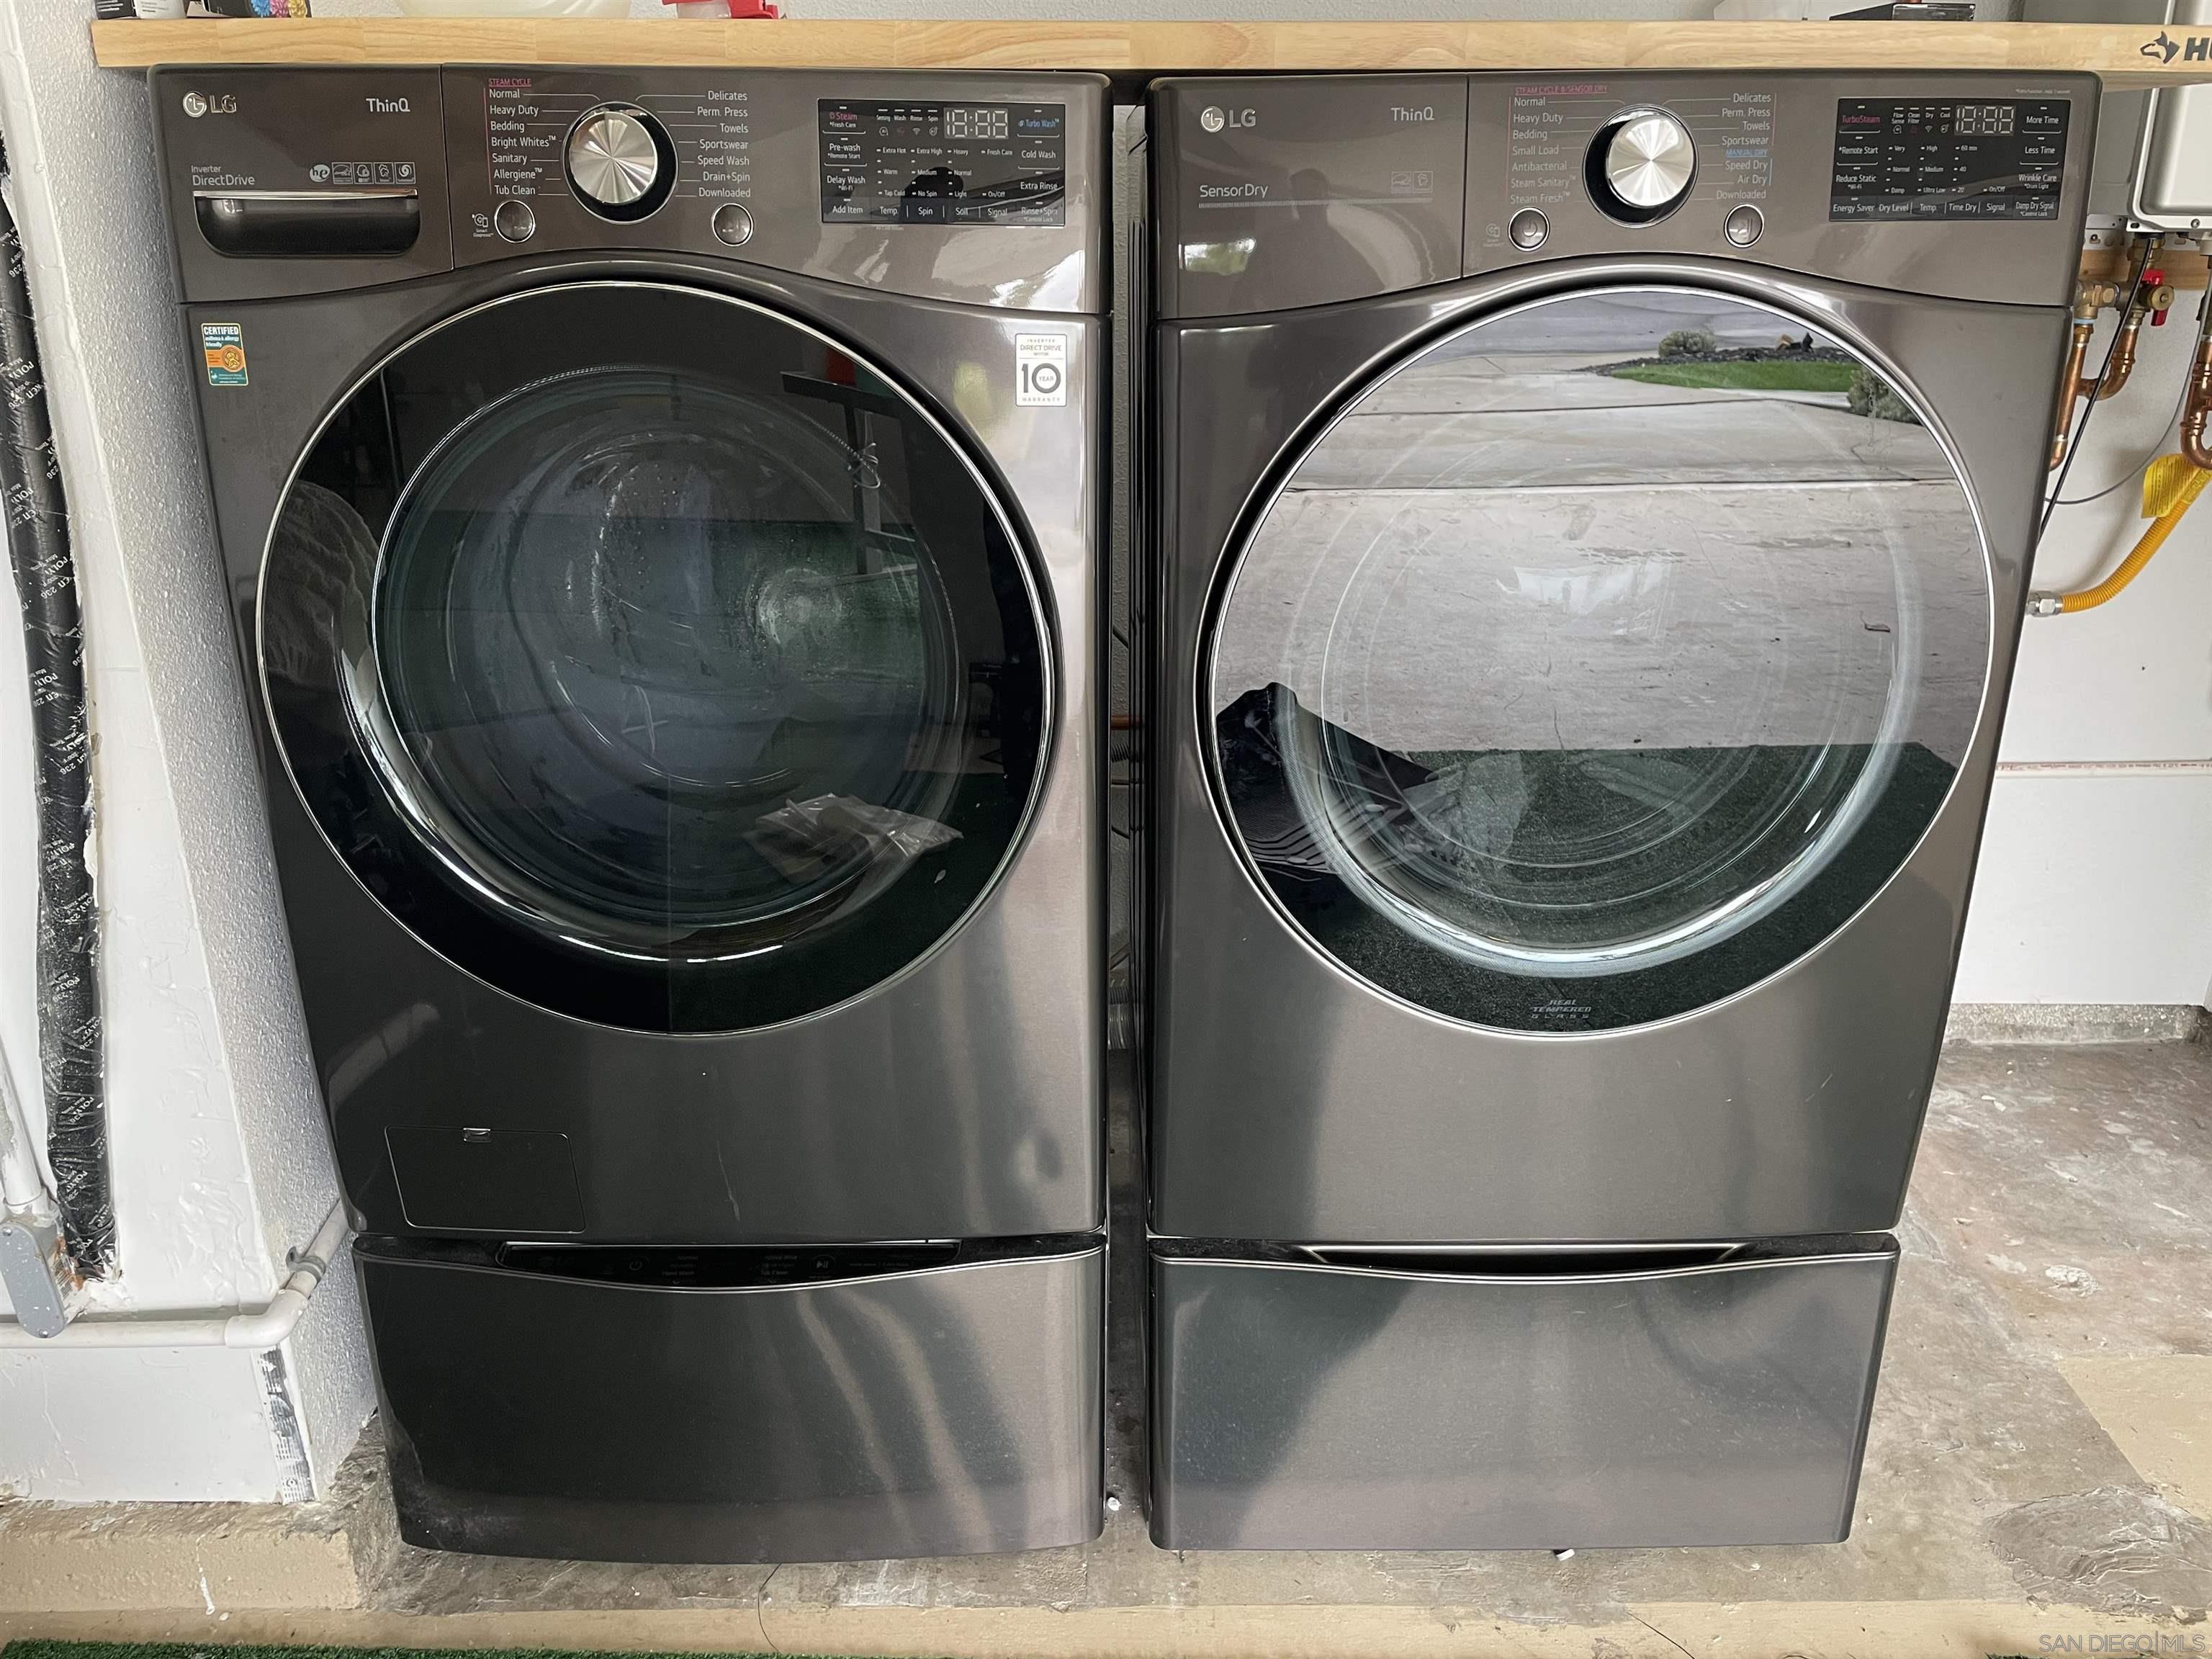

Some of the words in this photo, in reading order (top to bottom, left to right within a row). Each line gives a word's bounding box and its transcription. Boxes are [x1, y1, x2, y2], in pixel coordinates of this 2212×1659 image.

[489, 88, 520, 98] Normal
[708, 91, 747, 101] Delicates
[1733, 93, 1771, 103] Delicates
[366, 98, 410, 113] ThinQ
[1514, 96, 1545, 107] Normal
[490, 105, 516, 117] Heavy
[518, 105, 539, 117] Duty
[724, 107, 748, 117] Press
[1391, 107, 1435, 122] ThinQ
[1722, 108, 1745, 117] Perm.
[1748, 107, 1771, 117] Press
[1514, 114, 1539, 125] Heavy
[1542, 112, 1564, 124] Duty
[2044, 115, 2059, 124] Time
[490, 121, 525, 133] Bedding
[720, 122, 749, 133] Towels
[1743, 121, 1771, 131] Towels
[1512, 129, 1548, 141] Bedding
[491, 137, 517, 149] Bright
[699, 138, 749, 151] Sportswear
[1722, 135, 1769, 148] Sportswear
[830, 143, 861, 151] Pre-wash
[1512, 145, 1536, 156] Small
[1538, 145, 1560, 156] Load
[2041, 145, 2056, 154] Time
[1021, 150, 1037, 158] Cold
[1038, 150, 1056, 158] Wash
[492, 153, 527, 166] Sanitary
[697, 155, 724, 167] Speed
[726, 156, 750, 166] Wash
[1512, 161, 1567, 172] Antibacterial
[1725, 160, 1751, 171] Speed
[1753, 160, 1768, 171] Dry
[703, 171, 750, 184] Drain+Spin
[827, 176, 846, 185] Delay
[847, 176, 866, 184] Wash
[1737, 174, 1750, 184] Air
[1753, 174, 1768, 186] Dry
[1836, 174, 1858, 183] Reduce
[1858, 174, 1876, 183] Static
[494, 184, 510, 194] Tub
[511, 184, 536, 194] Clean
[1020, 181, 1038, 190] Extra
[1040, 181, 1058, 190] Rinse
[1511, 179, 1535, 189] Steam
[698, 187, 752, 197] Downloaded
[1717, 189, 1767, 200] Downloaded
[1510, 194, 1538, 204] Steam
[917, 207, 933, 216] Spin
[956, 207, 969, 216] Soil
[1833, 204, 1856, 214] Energy
[1856, 203, 1875, 212] Saver
[1879, 204, 1891, 213] Dry
[1892, 203, 1909, 212] Level
[1948, 203, 1964, 212] Time
[1965, 203, 1977, 213] Dry
[1986, 203, 2006, 213] Signal
[2030, 202, 2040, 211] Dry
[2040, 202, 2055, 211] Signal
[988, 207, 1008, 217] Signal
[203, 326, 239, 335] CERTIFIED
[1021, 363, 1061, 394] 10
